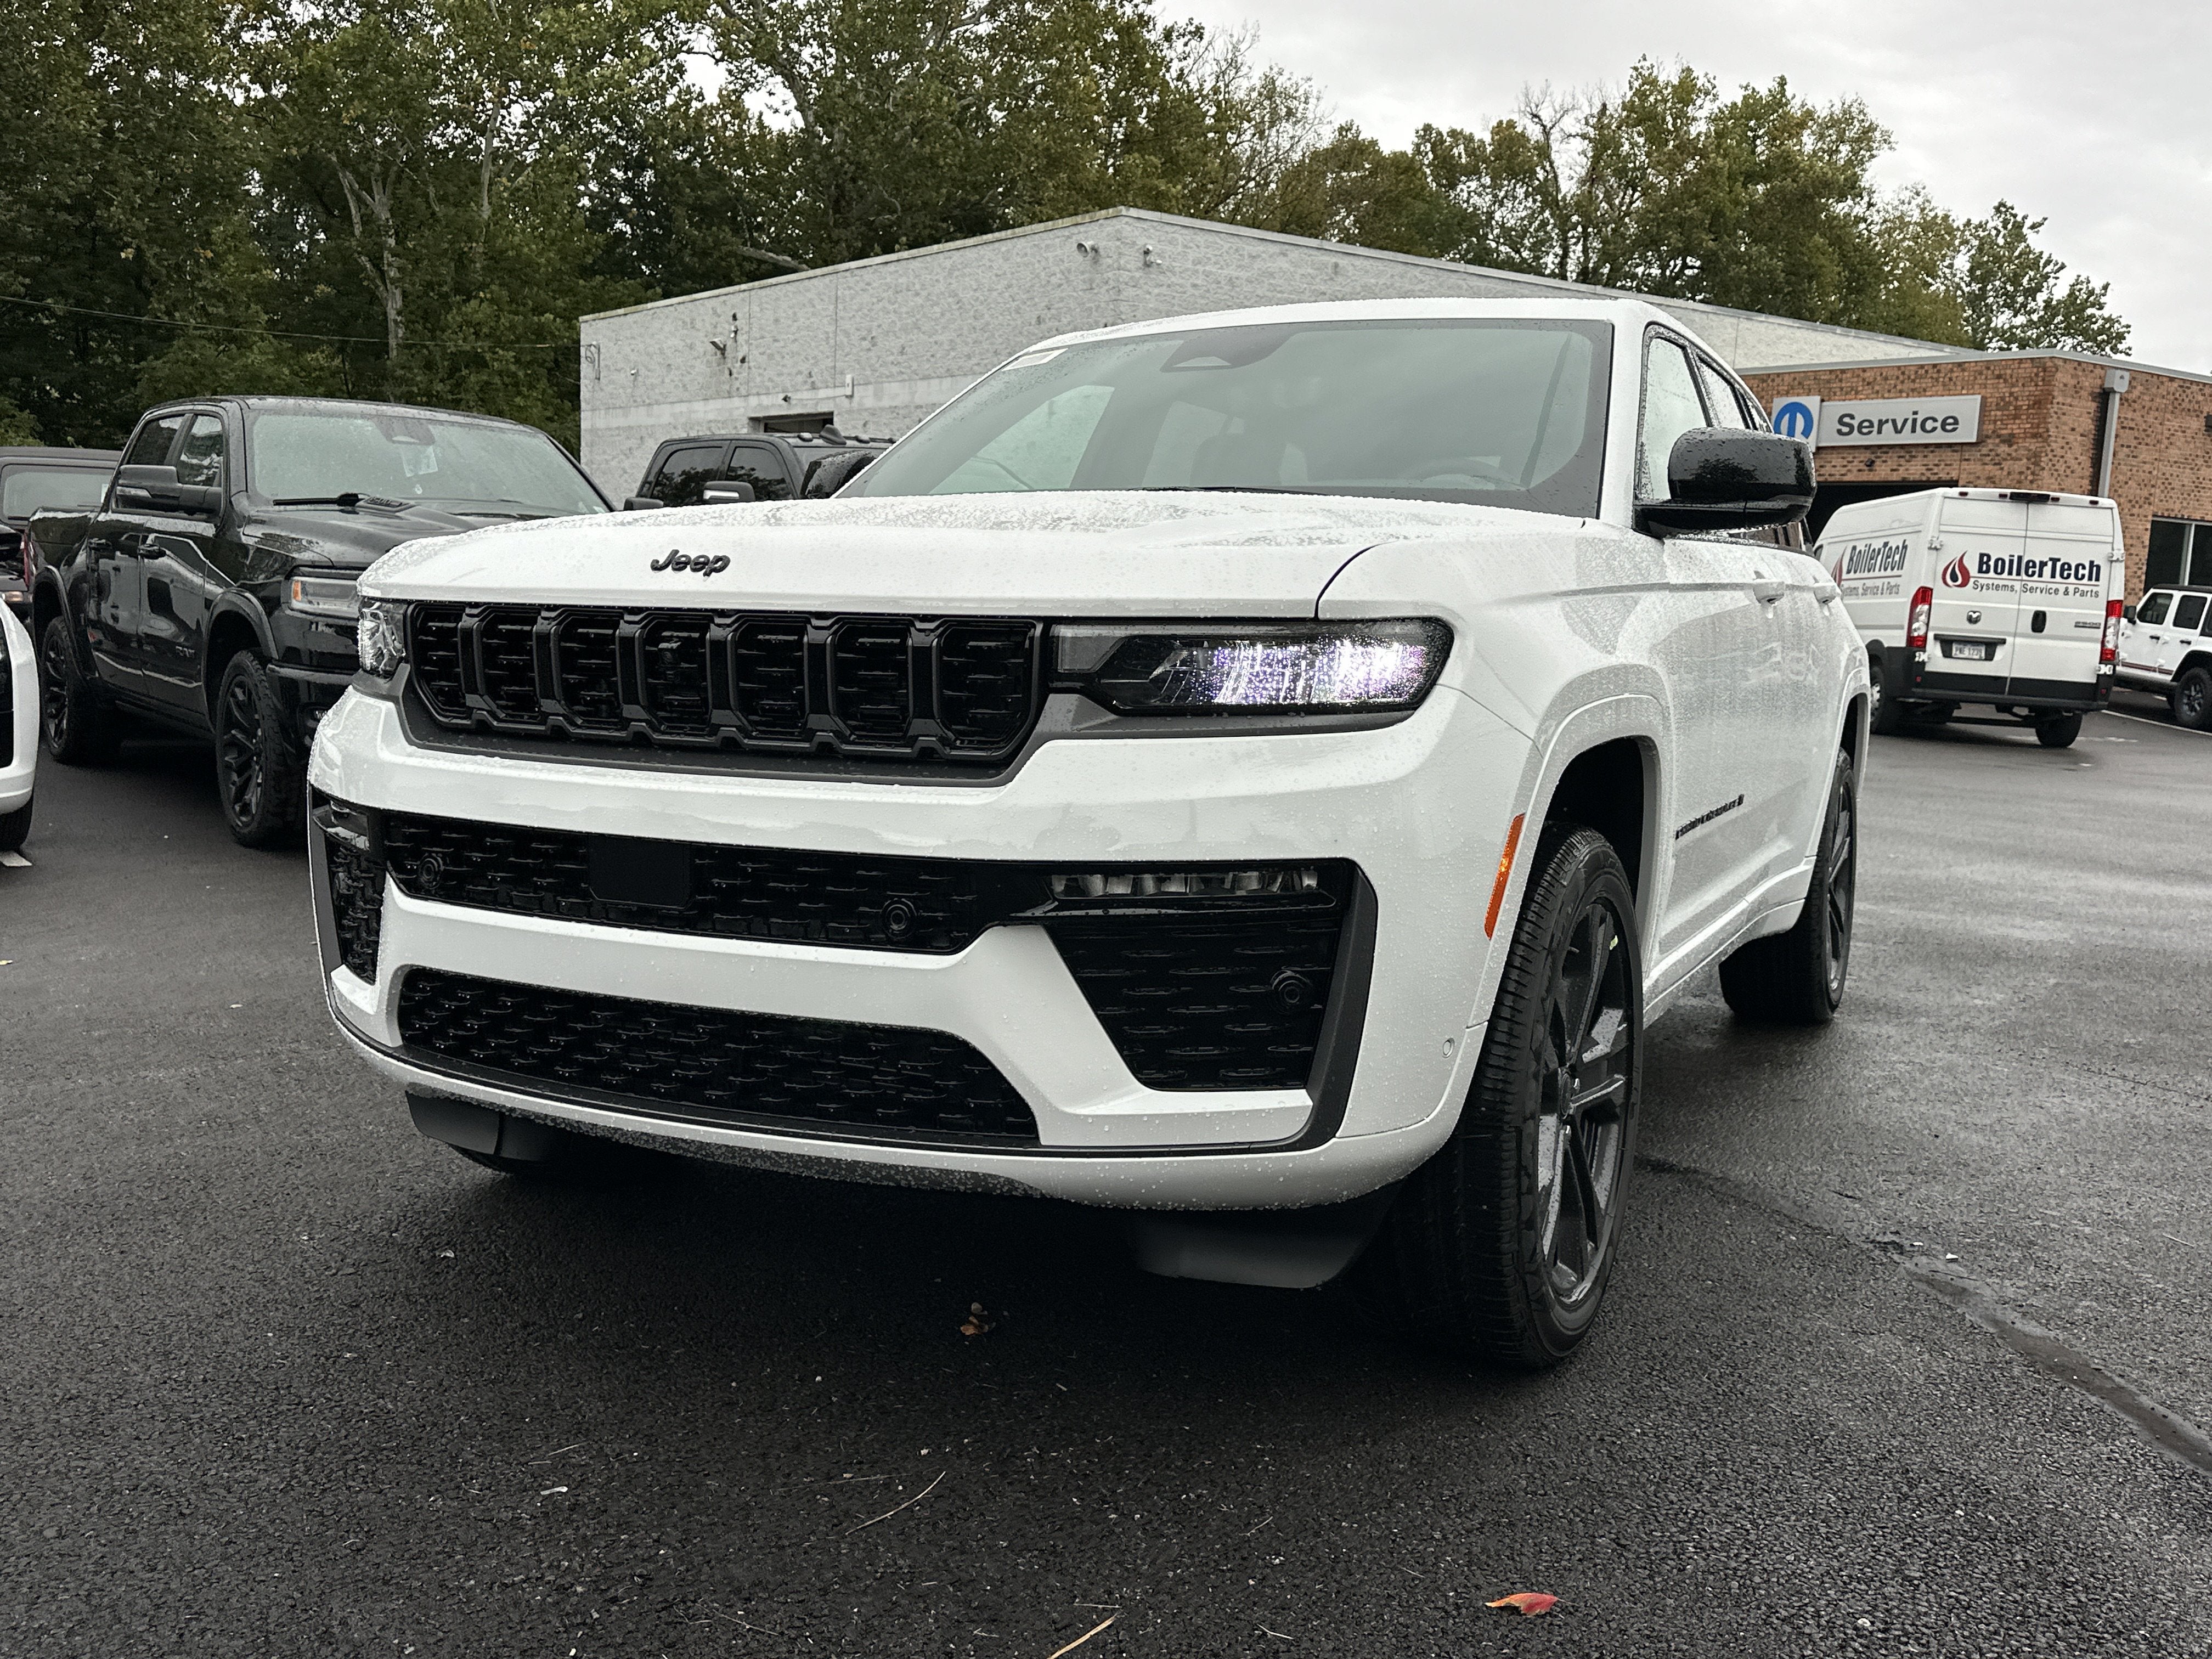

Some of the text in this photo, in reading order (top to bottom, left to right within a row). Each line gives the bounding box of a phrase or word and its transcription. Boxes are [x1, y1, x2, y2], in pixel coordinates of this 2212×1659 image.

[1836, 410, 1959, 436] Service
[650, 549, 731, 577] Jeep
[1846, 539, 1908, 574] BoilerTech
[1977, 552, 2101, 582] BoilerTech
[1972, 580, 2100, 598] Systems, Service & Parts
